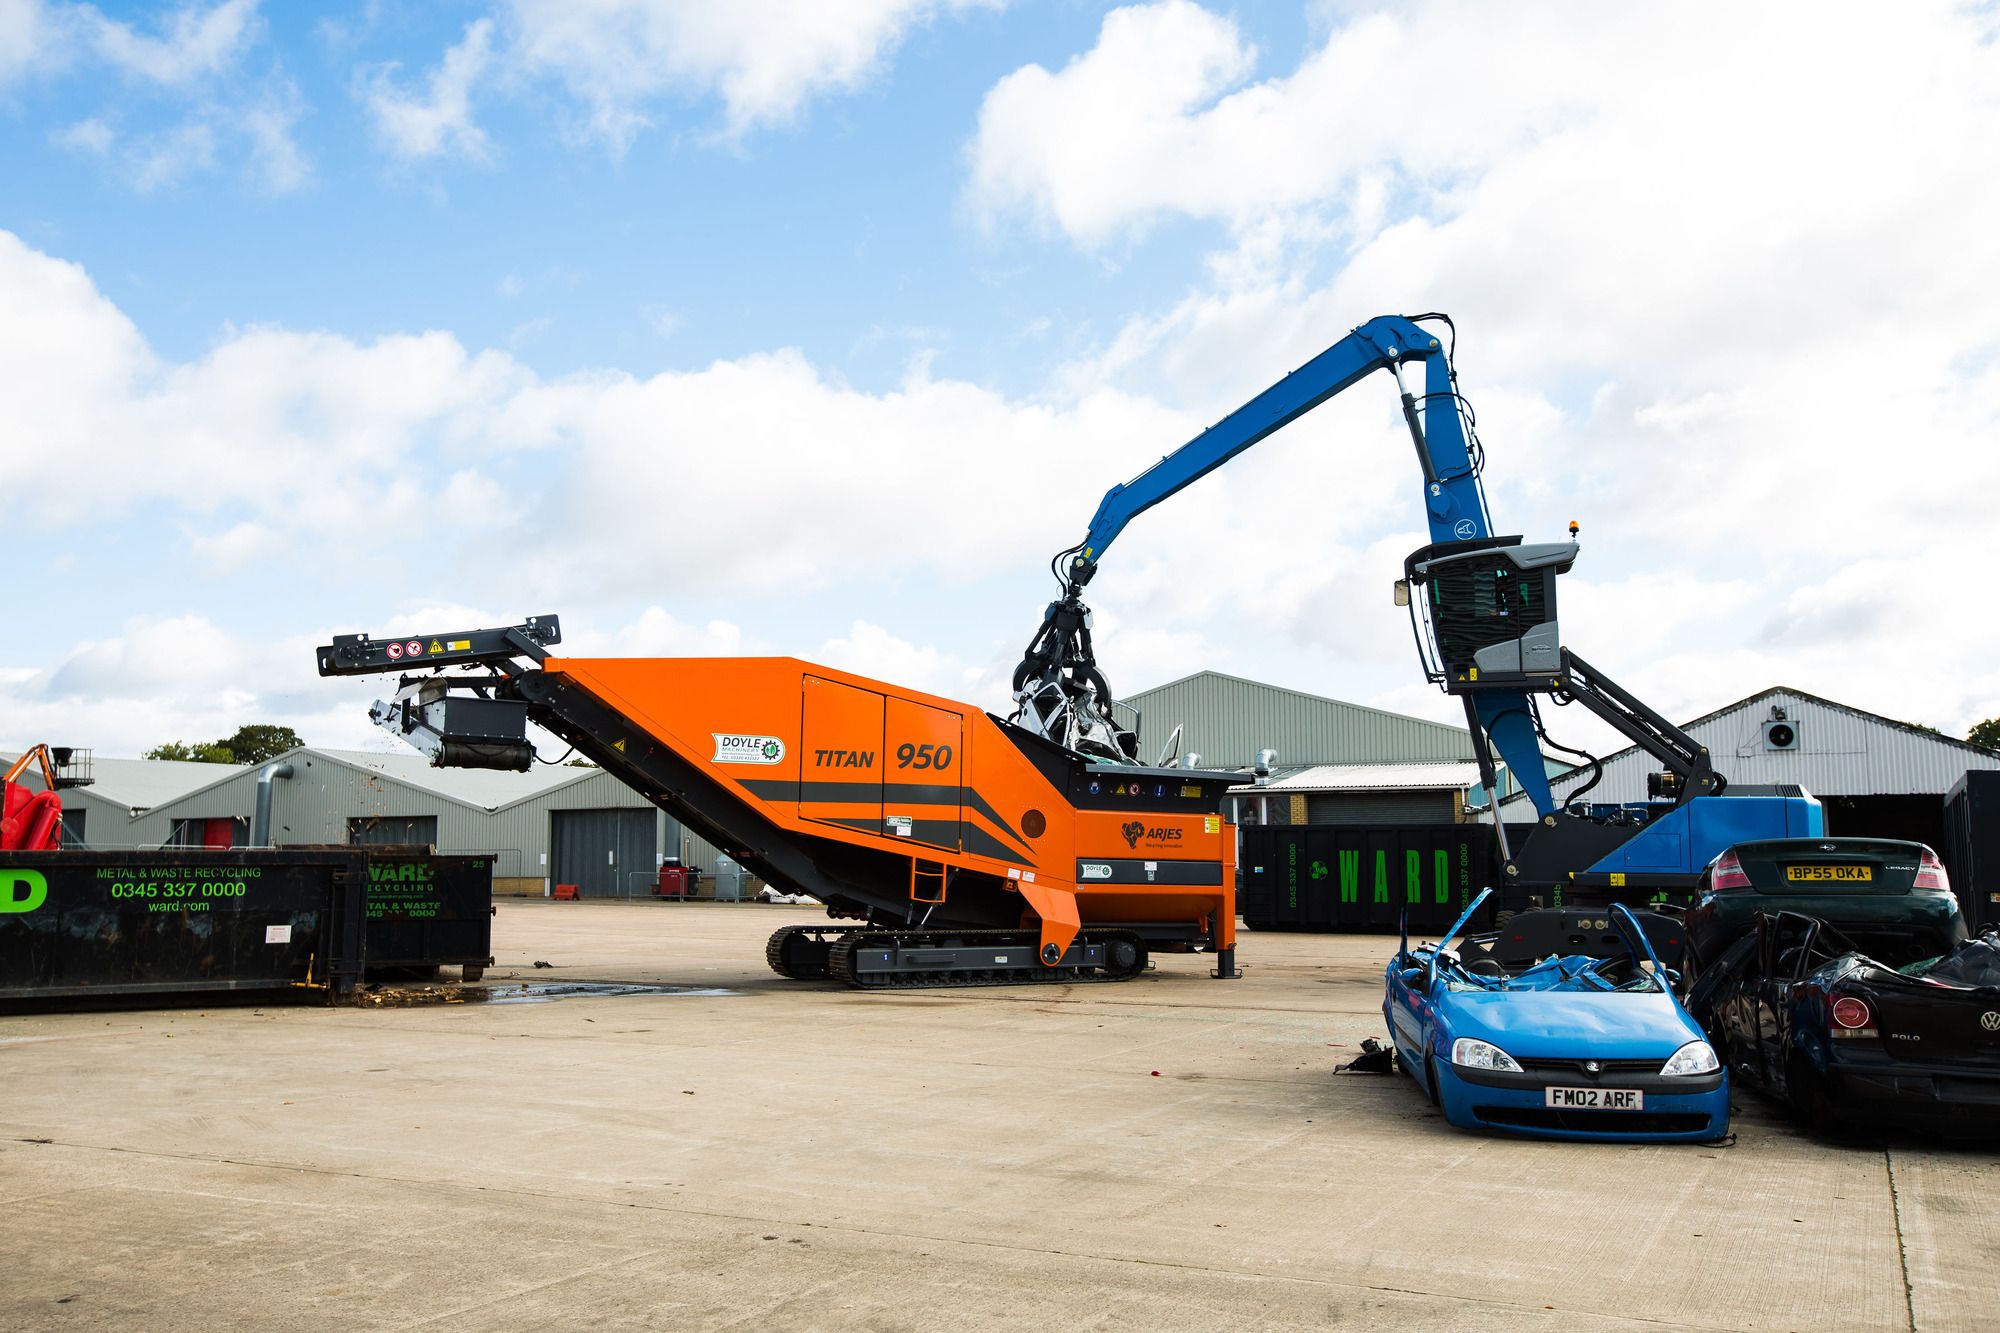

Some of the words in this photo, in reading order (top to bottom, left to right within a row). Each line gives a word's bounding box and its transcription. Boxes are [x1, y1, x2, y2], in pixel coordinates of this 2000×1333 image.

[722, 737, 761, 748] DOYLE
[815, 750, 874, 768] TITAN
[896, 743, 953, 770] 950
[1146, 827, 1183, 842] ARJES
[1289, 842, 1297, 865] 0000
[1460, 843, 1468, 866] 0000
[472, 860, 485, 868] 25
[97, 868, 136, 879] METAL
[139, 868, 147, 878] &
[151, 868, 191, 878] WASTE
[195, 867, 261, 878] RECYCLING
[1794, 867, 1832, 878] BP55
[1836, 867, 1865, 878] OKA
[111, 883, 158, 897] 0345
[163, 882, 197, 897] 337
[202, 882, 246, 897] 0000
[367, 884, 434, 892] ECYCLING
[1289, 885, 1297, 908] 0345
[148, 900, 210, 912] ward.com
[403, 902, 441, 910] WASTE
[409, 910, 437, 918] 0000
[1891, 1033, 1921, 1041] POLO
[1552, 1089, 1598, 1106] FM02
[1603, 1091, 1636, 1108] ARF
